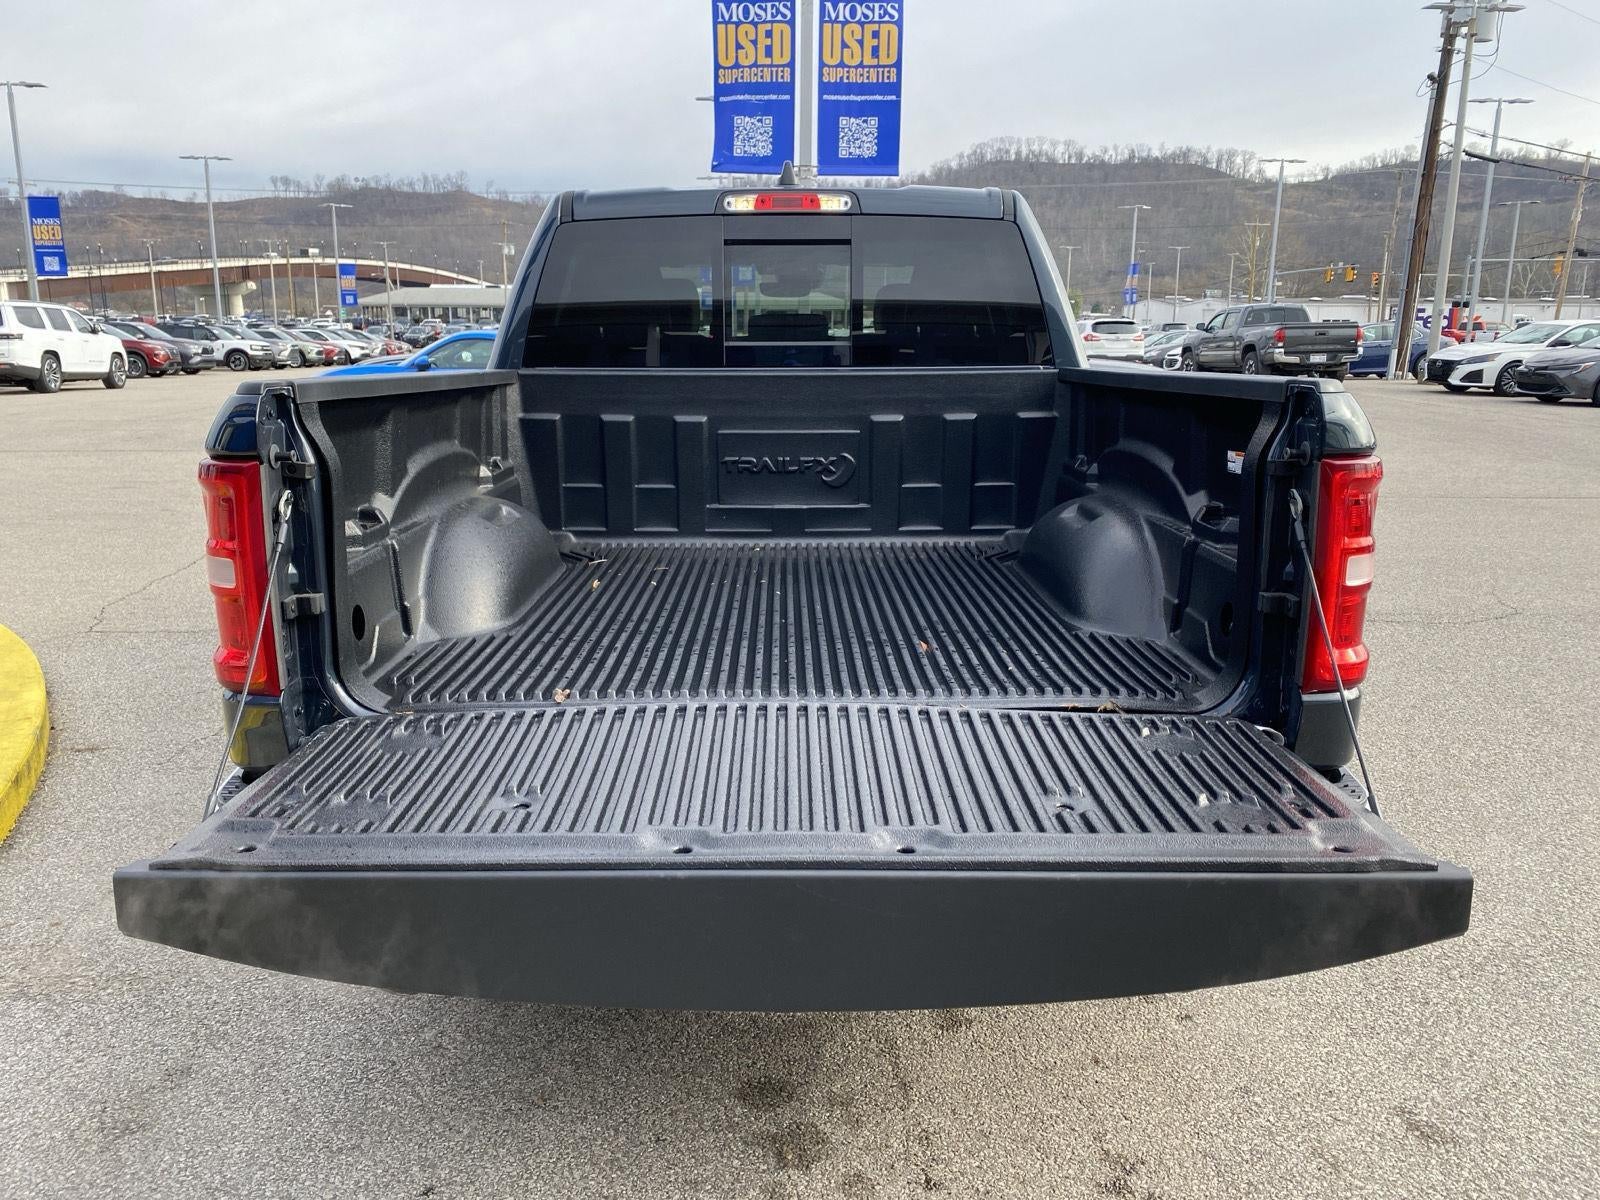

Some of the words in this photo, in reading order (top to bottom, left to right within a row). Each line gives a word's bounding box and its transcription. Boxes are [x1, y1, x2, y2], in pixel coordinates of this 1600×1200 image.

[717, 2, 792, 22] MOSES
[824, 2, 899, 22] MOSES
[717, 23, 791, 67] USED
[823, 23, 899, 66] USED
[718, 67, 791, 84] SUPERCENTER
[822, 67, 897, 83] SUPERCENTER
[32, 217, 61, 225] MOSES
[33, 225, 62, 240] USED
[721, 455, 842, 478] TRAILFX
